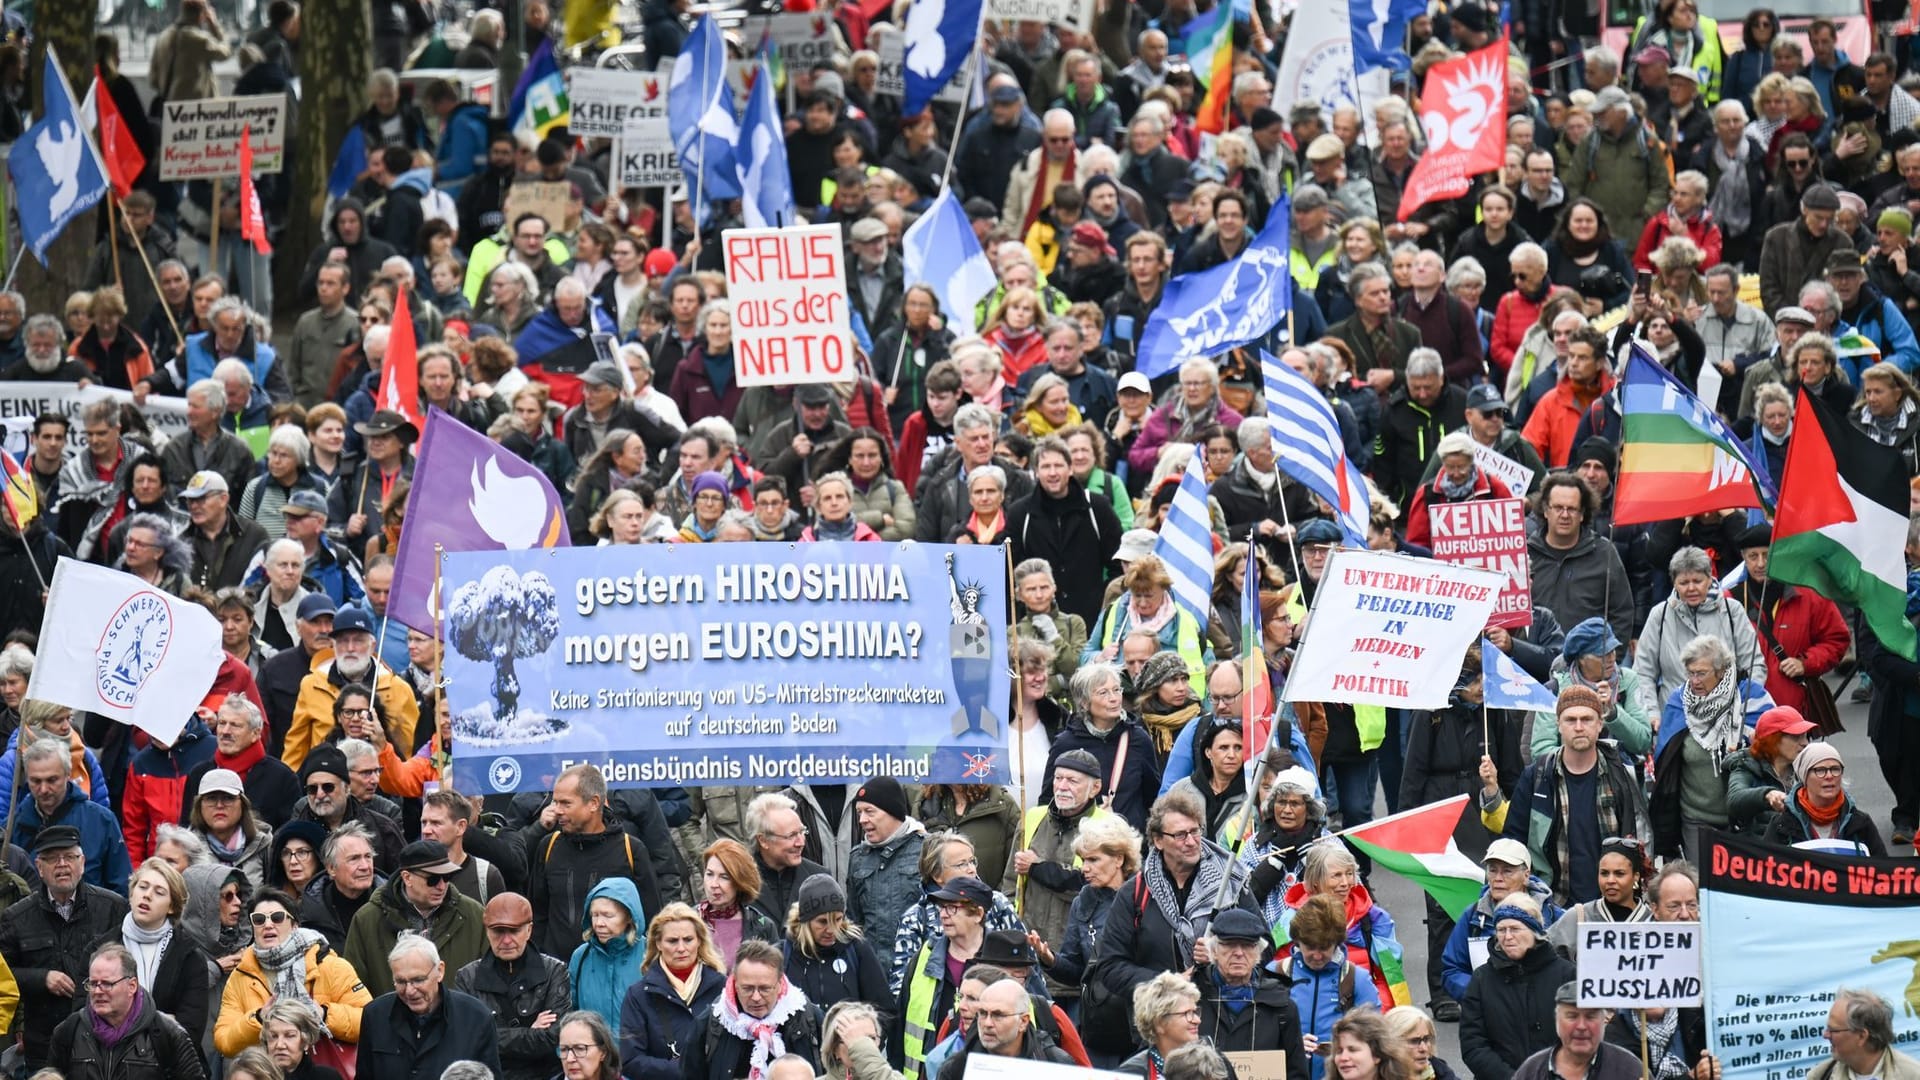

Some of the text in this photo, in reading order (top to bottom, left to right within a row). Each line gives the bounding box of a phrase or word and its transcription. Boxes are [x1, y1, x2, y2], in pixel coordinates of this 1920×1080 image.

[167, 101, 279, 124] Verhandlungen
[624, 152, 682, 171] KRIE
[728, 235, 837, 284] RAUS
[737, 286, 843, 328] aus der
[740, 334, 844, 377] NATO
[1474, 446, 1529, 483] RESDEN
[1430, 501, 1525, 538] KEINE
[1433, 535, 1526, 555] AUFRÜSTUNG
[576, 562, 910, 616] gestern HIROSHIMA
[1344, 567, 1492, 602] UNTERWÜRFIGE
[1355, 593, 1456, 622] FEIGLINGE
[1494, 594, 1530, 613] RIEG
[109, 598, 167, 640] SCHWERTER
[1382, 620, 1408, 636] IN
[564, 619, 923, 672] morgen EUROSHIMA?
[1350, 638, 1426, 660] MEDIEN
[550, 682, 945, 712] Keine Stationierung von US-Mittelstreckenraketen
[1331, 674, 1410, 698] POLITIK
[665, 712, 838, 737] auf deutschem Boden
[748, 752, 930, 778] Norddeutschland
[1711, 844, 1838, 894] Deutsche
[1586, 929, 1693, 950] FRIEDEN
[1581, 976, 1701, 1000] RUSSLAND
[1735, 993, 1760, 1008] Die
[1717, 1009, 1828, 1028] sind verantwo
[1719, 1032, 1743, 1049] für
[1746, 1032, 1765, 1048] 70
[1769, 1028, 1785, 1043] %
[1790, 1024, 1825, 1041] aller
[1731, 1051, 1761, 1068] und
[1766, 1048, 1802, 1063] allen
[1766, 1068, 1780, 1080] in
